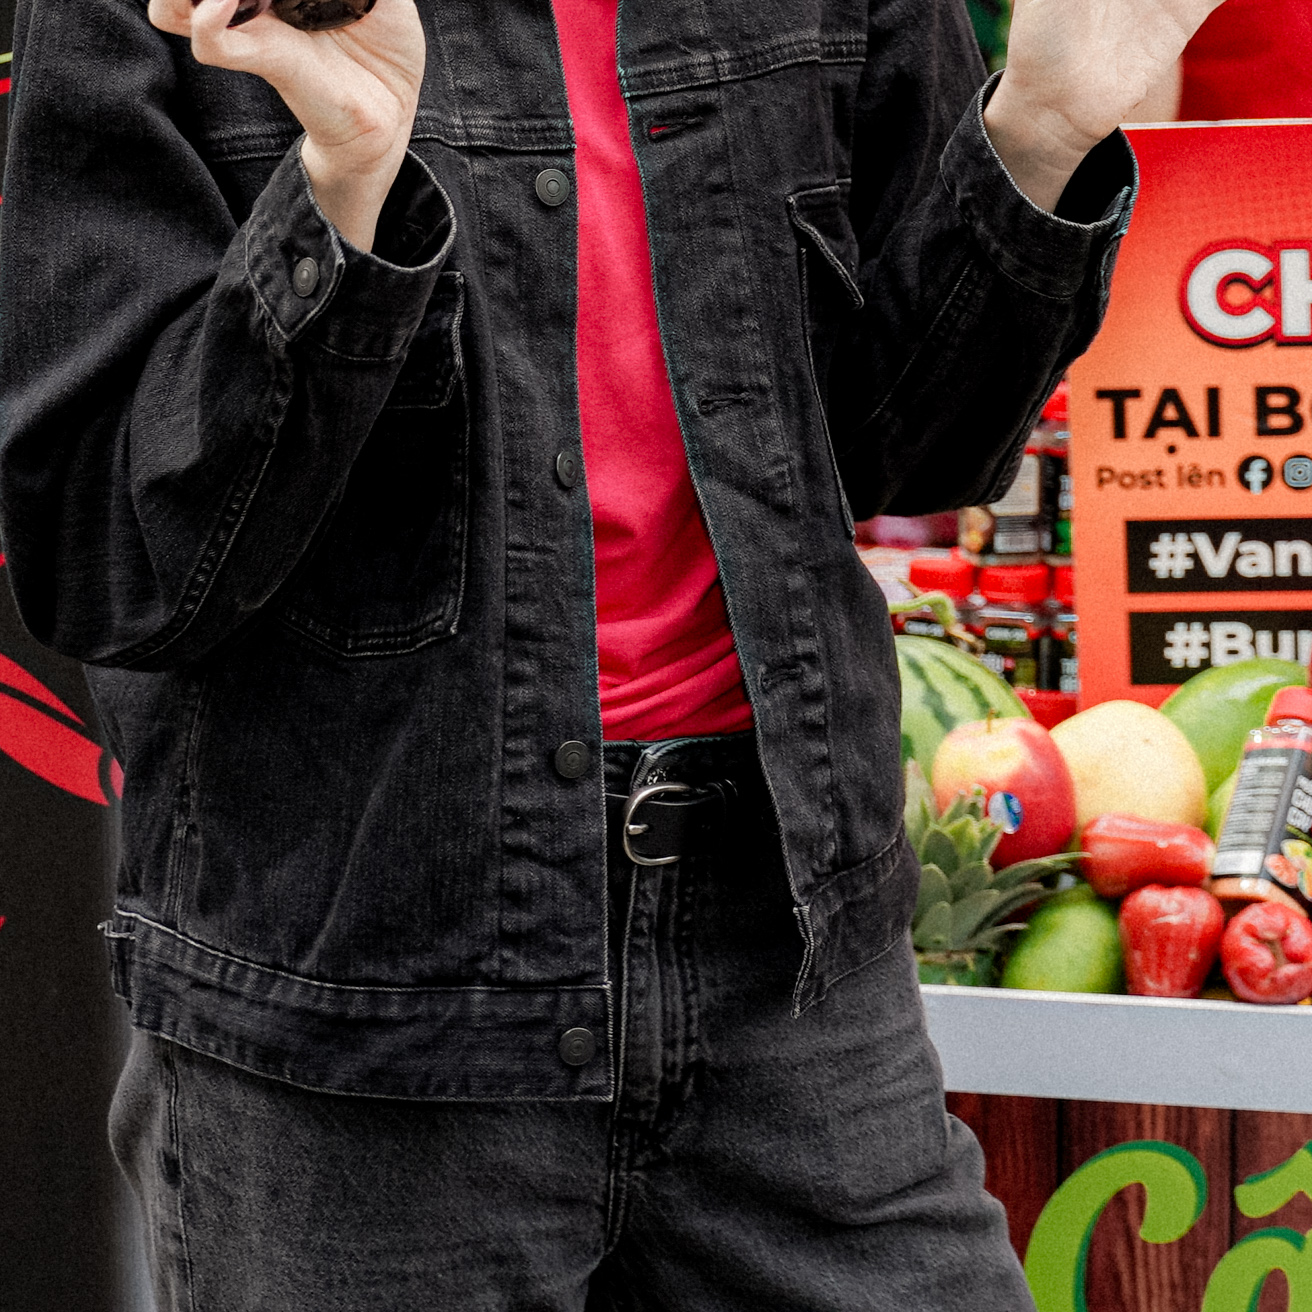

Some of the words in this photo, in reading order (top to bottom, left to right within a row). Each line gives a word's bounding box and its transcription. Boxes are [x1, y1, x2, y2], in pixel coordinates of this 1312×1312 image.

[1095, 384, 1222, 455] TẠI
[1096, 464, 1169, 491] Post
[1175, 461, 1227, 489] lên
